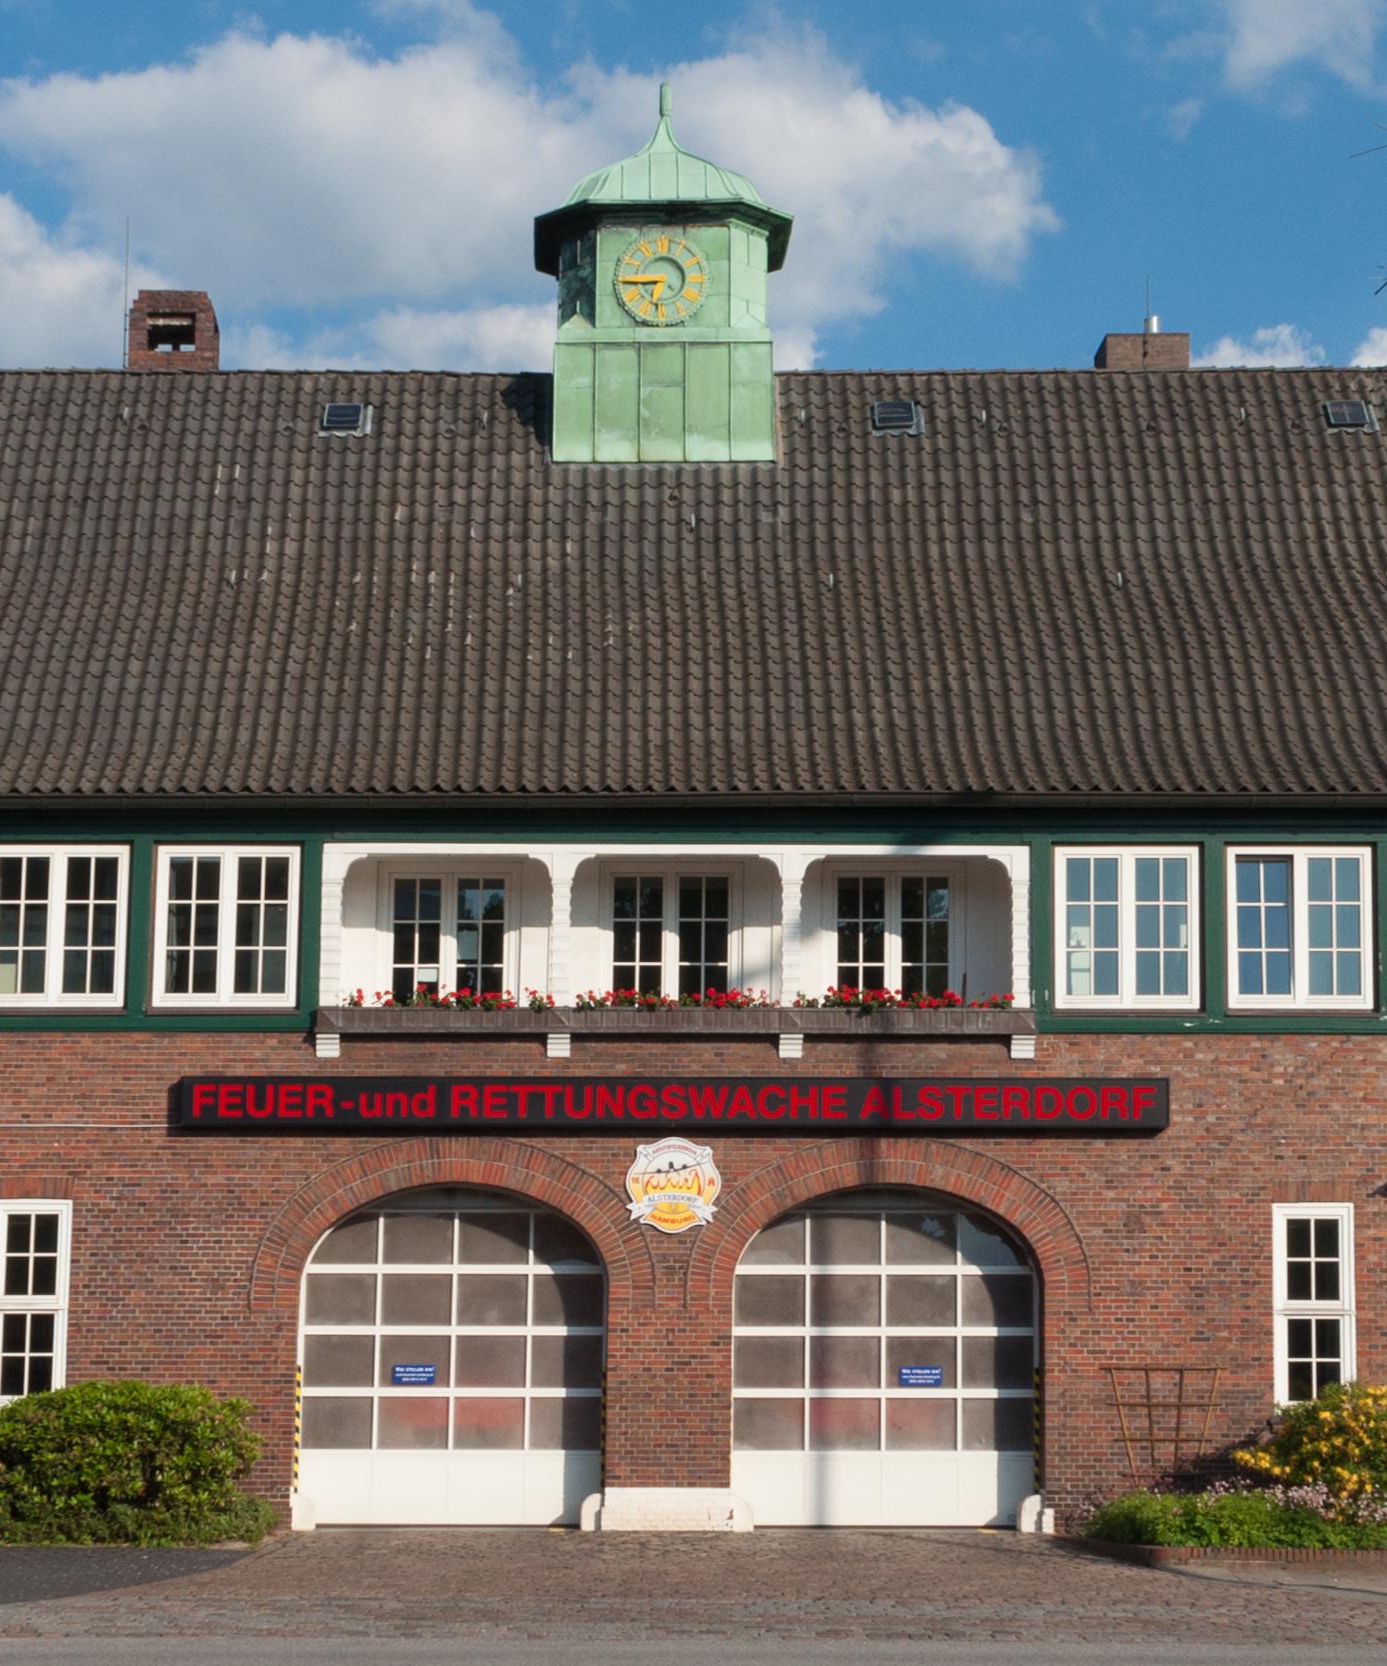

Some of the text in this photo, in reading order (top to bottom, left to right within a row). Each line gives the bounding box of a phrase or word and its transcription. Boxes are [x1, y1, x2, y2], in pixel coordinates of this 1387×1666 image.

[450, 1084, 848, 1119] RETTUNGSWACHE
[860, 1084, 1157, 1120] ALSTERDORF
[647, 1193, 698, 1203] ALSTERDORF
[650, 1213, 696, 1224] HAMBURG
